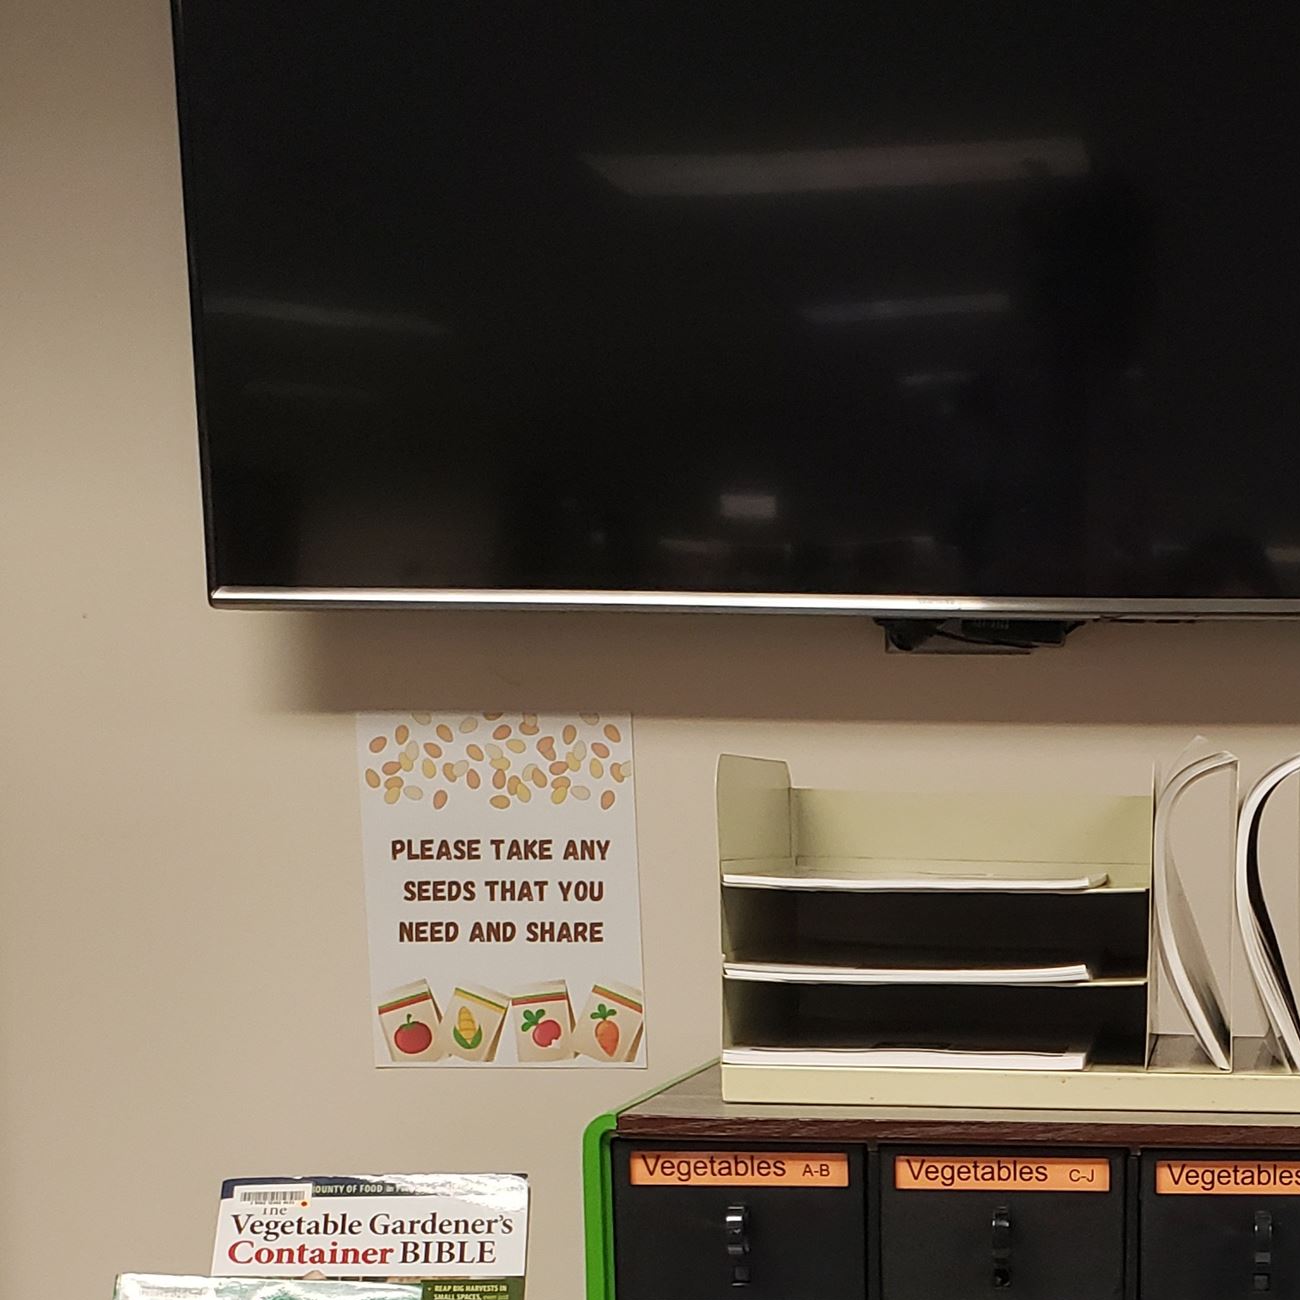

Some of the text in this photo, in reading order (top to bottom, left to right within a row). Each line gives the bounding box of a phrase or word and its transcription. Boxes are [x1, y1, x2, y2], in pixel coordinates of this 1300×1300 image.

[391, 839, 611, 861] PLEASE TAKE ANY
[404, 881, 604, 901] SEEDS THAT YOU
[399, 922, 604, 943] NEED AND SHARE
[642, 1154, 831, 1182] Vegetables A-B
[907, 1159, 1095, 1187] Vegetables C-J
[312, 1184, 345, 1194] OUNTY
[346, 1184, 358, 1194] OF
[360, 1183, 383, 1193] FOOD
[230, 1212, 513, 1242] Vegetable Gardener's
[228, 1240, 496, 1264] Container BIBLE
